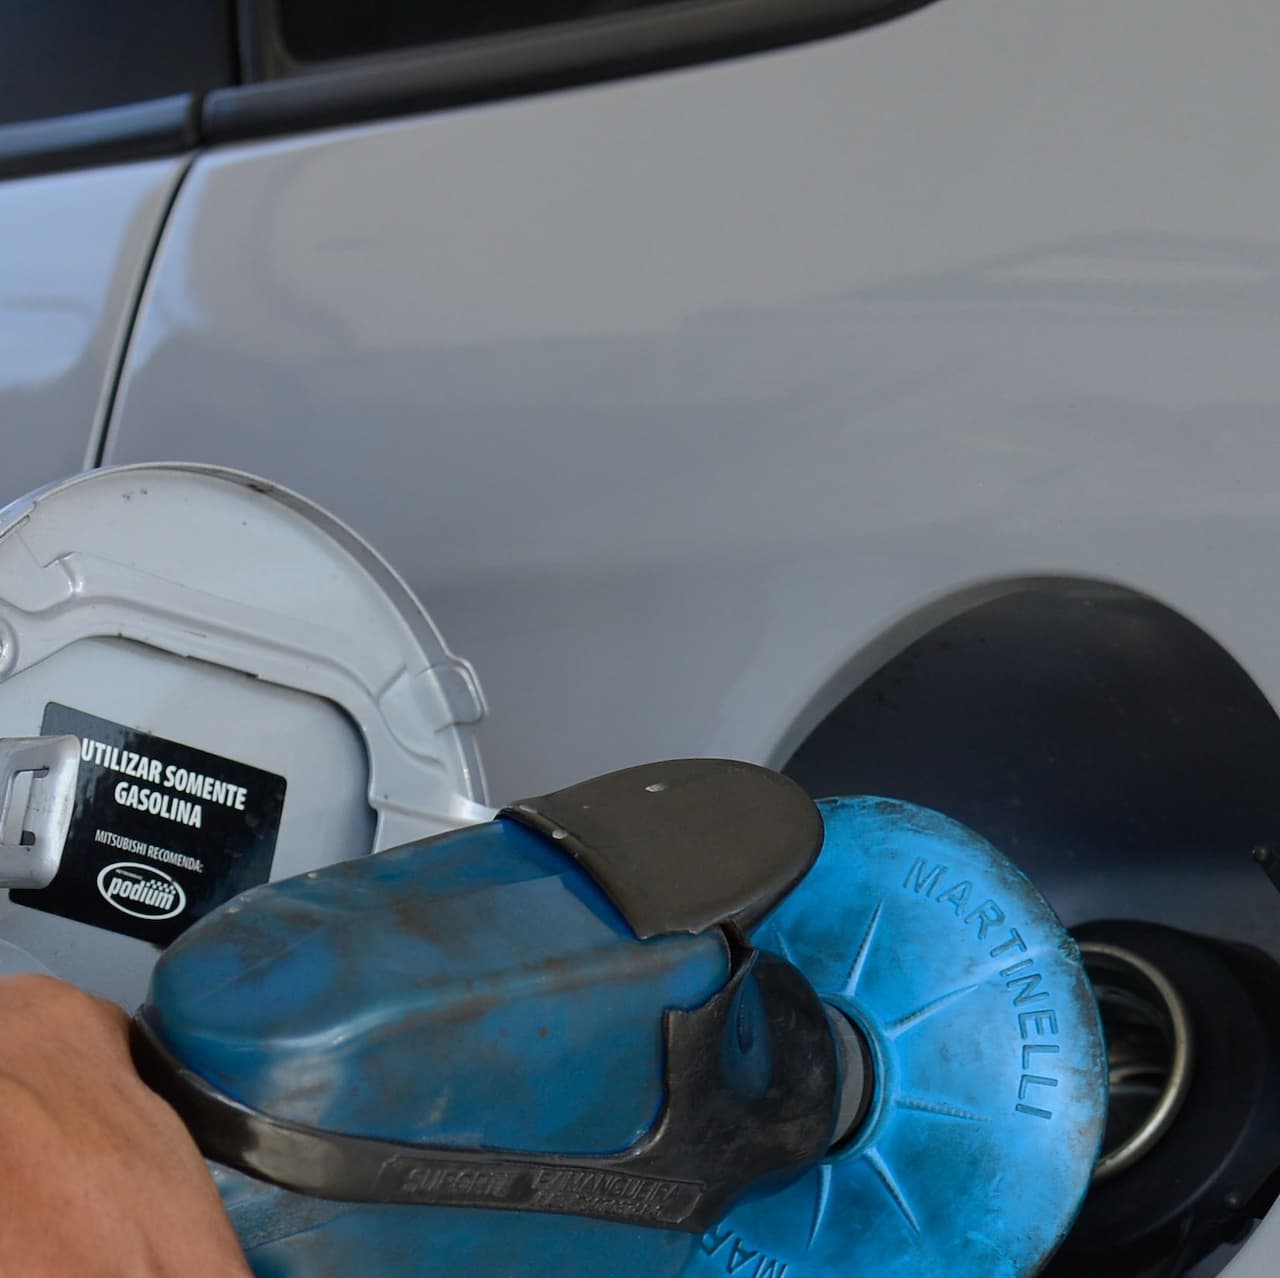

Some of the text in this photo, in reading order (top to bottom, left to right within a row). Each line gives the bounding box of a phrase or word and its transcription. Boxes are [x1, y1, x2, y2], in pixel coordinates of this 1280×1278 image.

[81, 738, 247, 811] UTILIZAR SOMENTE
[114, 782, 202, 828] GASOLINA
[94, 829, 203, 873] MITSUBISHI RECOMENDA:
[107, 877, 175, 911] podium
[902, 857, 1061, 1121] MARTINELLI
